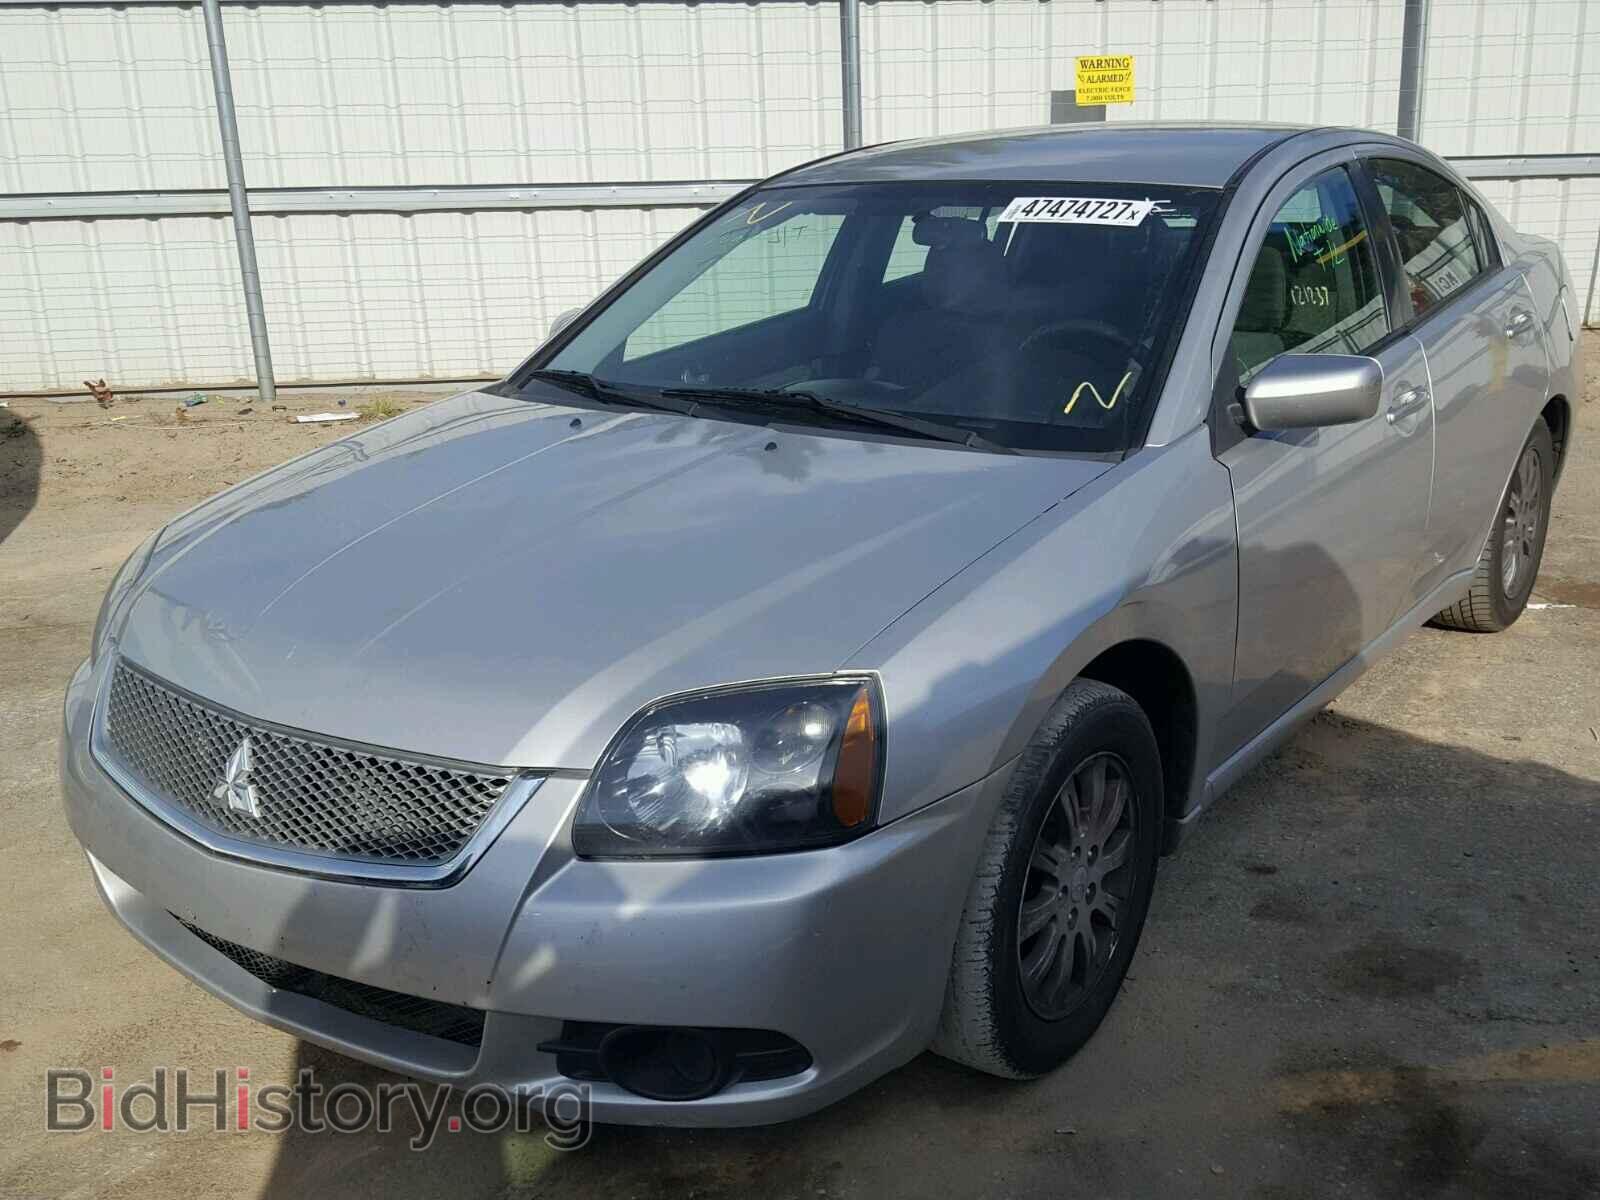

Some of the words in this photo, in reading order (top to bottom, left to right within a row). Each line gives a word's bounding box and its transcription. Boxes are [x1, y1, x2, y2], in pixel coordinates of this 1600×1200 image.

[1080, 57, 1130, 69] WARNING
[1087, 74, 1124, 84] ALARMED
[1021, 199, 1134, 220] 47474727
